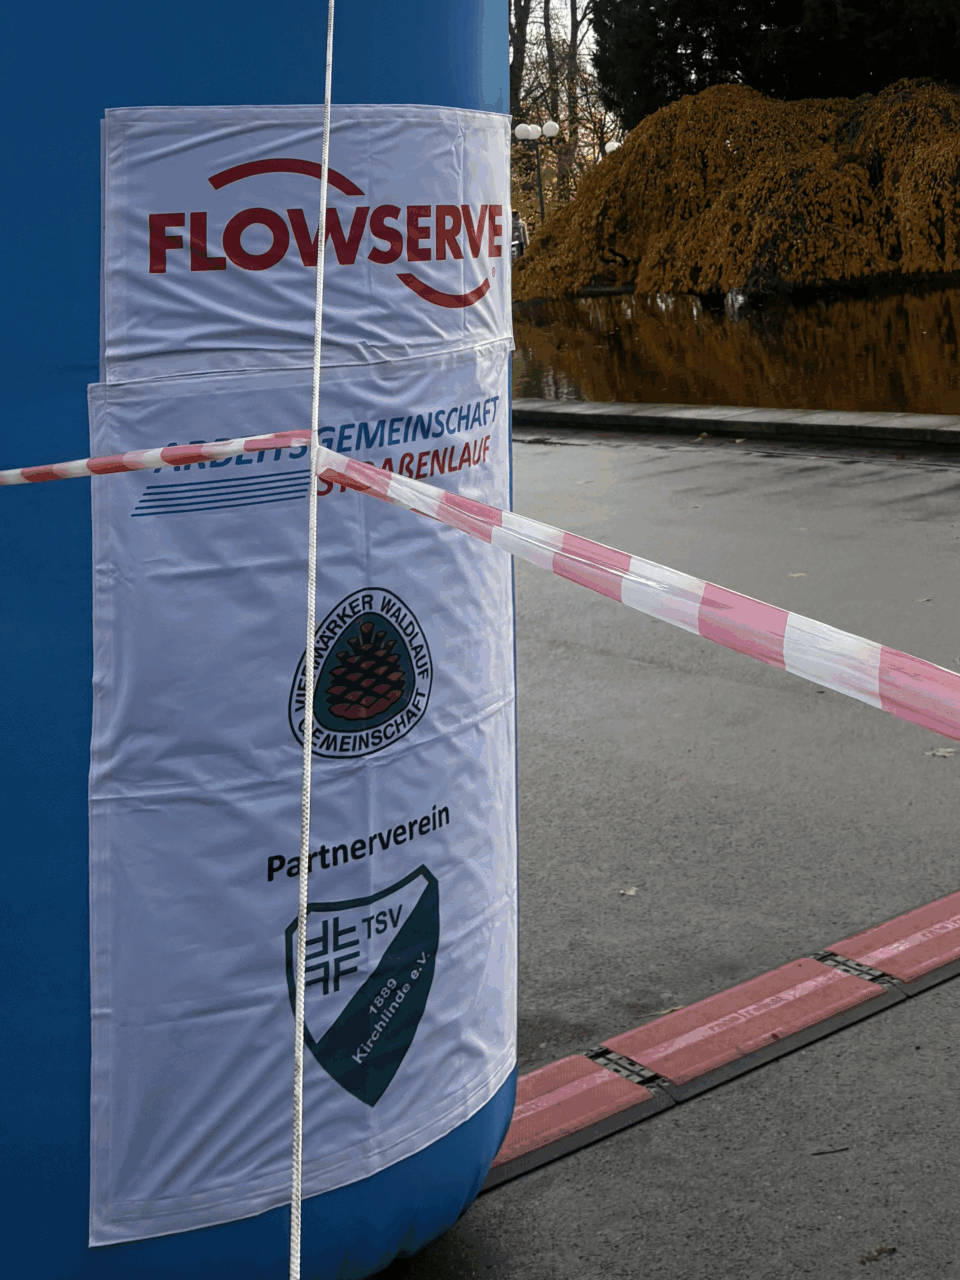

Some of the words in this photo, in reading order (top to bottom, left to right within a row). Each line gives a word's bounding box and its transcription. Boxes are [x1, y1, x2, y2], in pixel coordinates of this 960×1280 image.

[148, 204, 502, 274] FLOWSERVE
[381, 595, 429, 680] WALDLAUF
[267, 804, 450, 882] Partnerverein
[361, 904, 403, 940] TSV
[351, 982, 410, 1064] Kirchlinde
[409, 951, 430, 981] e.V.
[368, 977, 397, 1015] 1889
